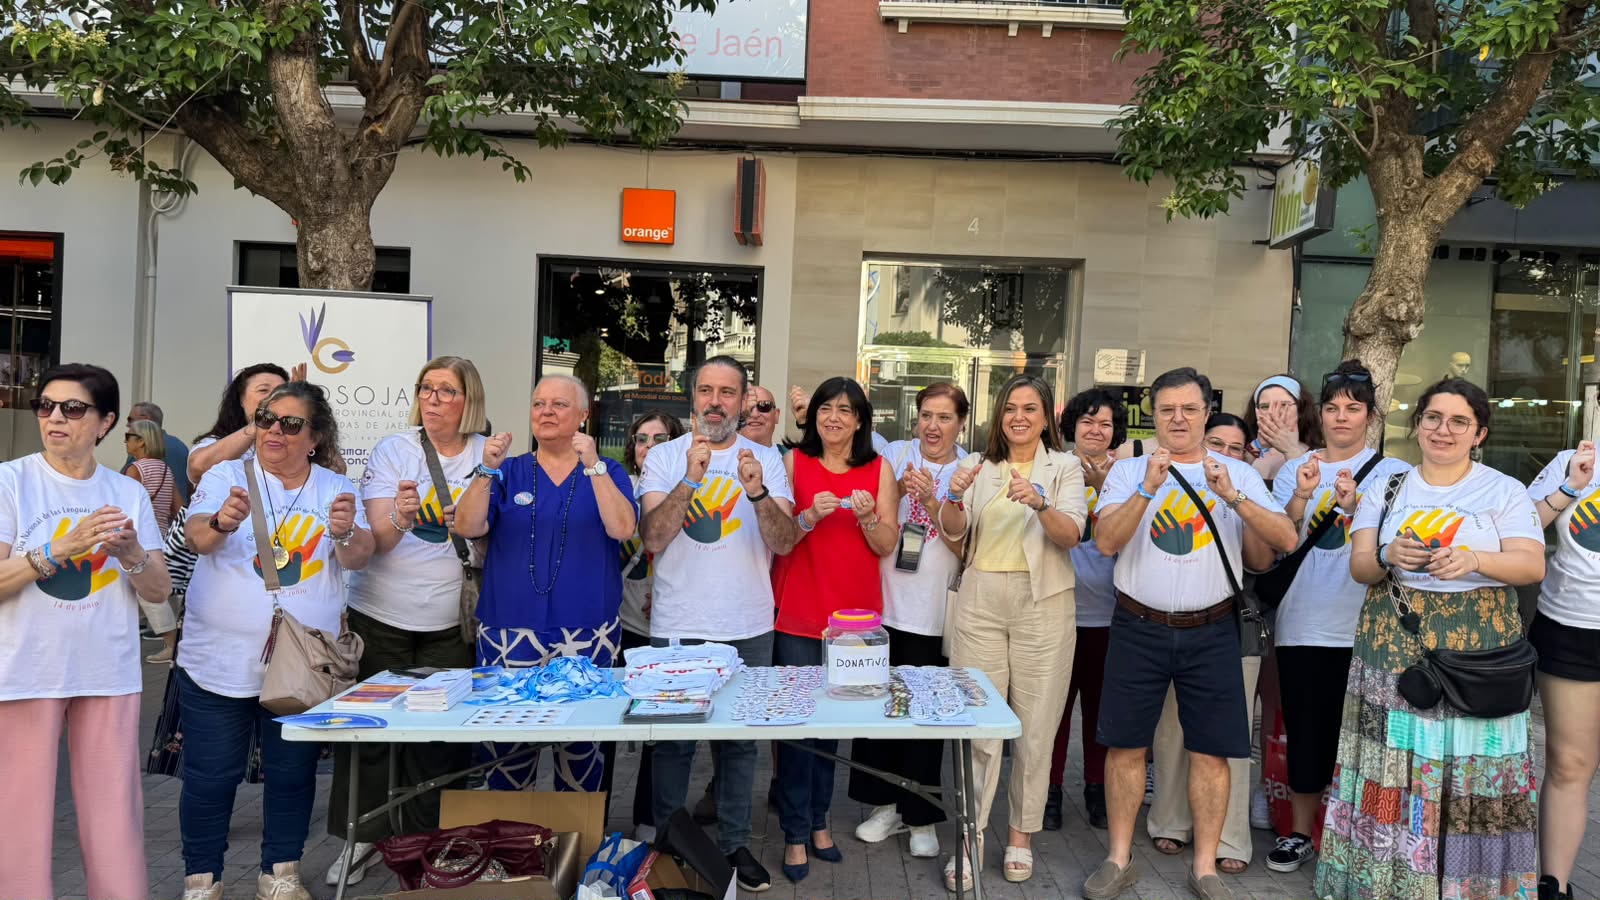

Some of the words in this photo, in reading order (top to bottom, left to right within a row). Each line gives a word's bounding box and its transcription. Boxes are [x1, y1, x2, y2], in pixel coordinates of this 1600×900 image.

[707, 27, 783, 58] Jaén
[967, 216, 980, 236] 4
[623, 227, 669, 241] orange
[335, 408, 393, 418] ROVINCIAL
[337, 421, 360, 429] DAS
[366, 422, 379, 430] DE
[62, 506, 91, 514] Lenguas
[79, 602, 100, 612] junio
[836, 657, 888, 668] DONATIVO
